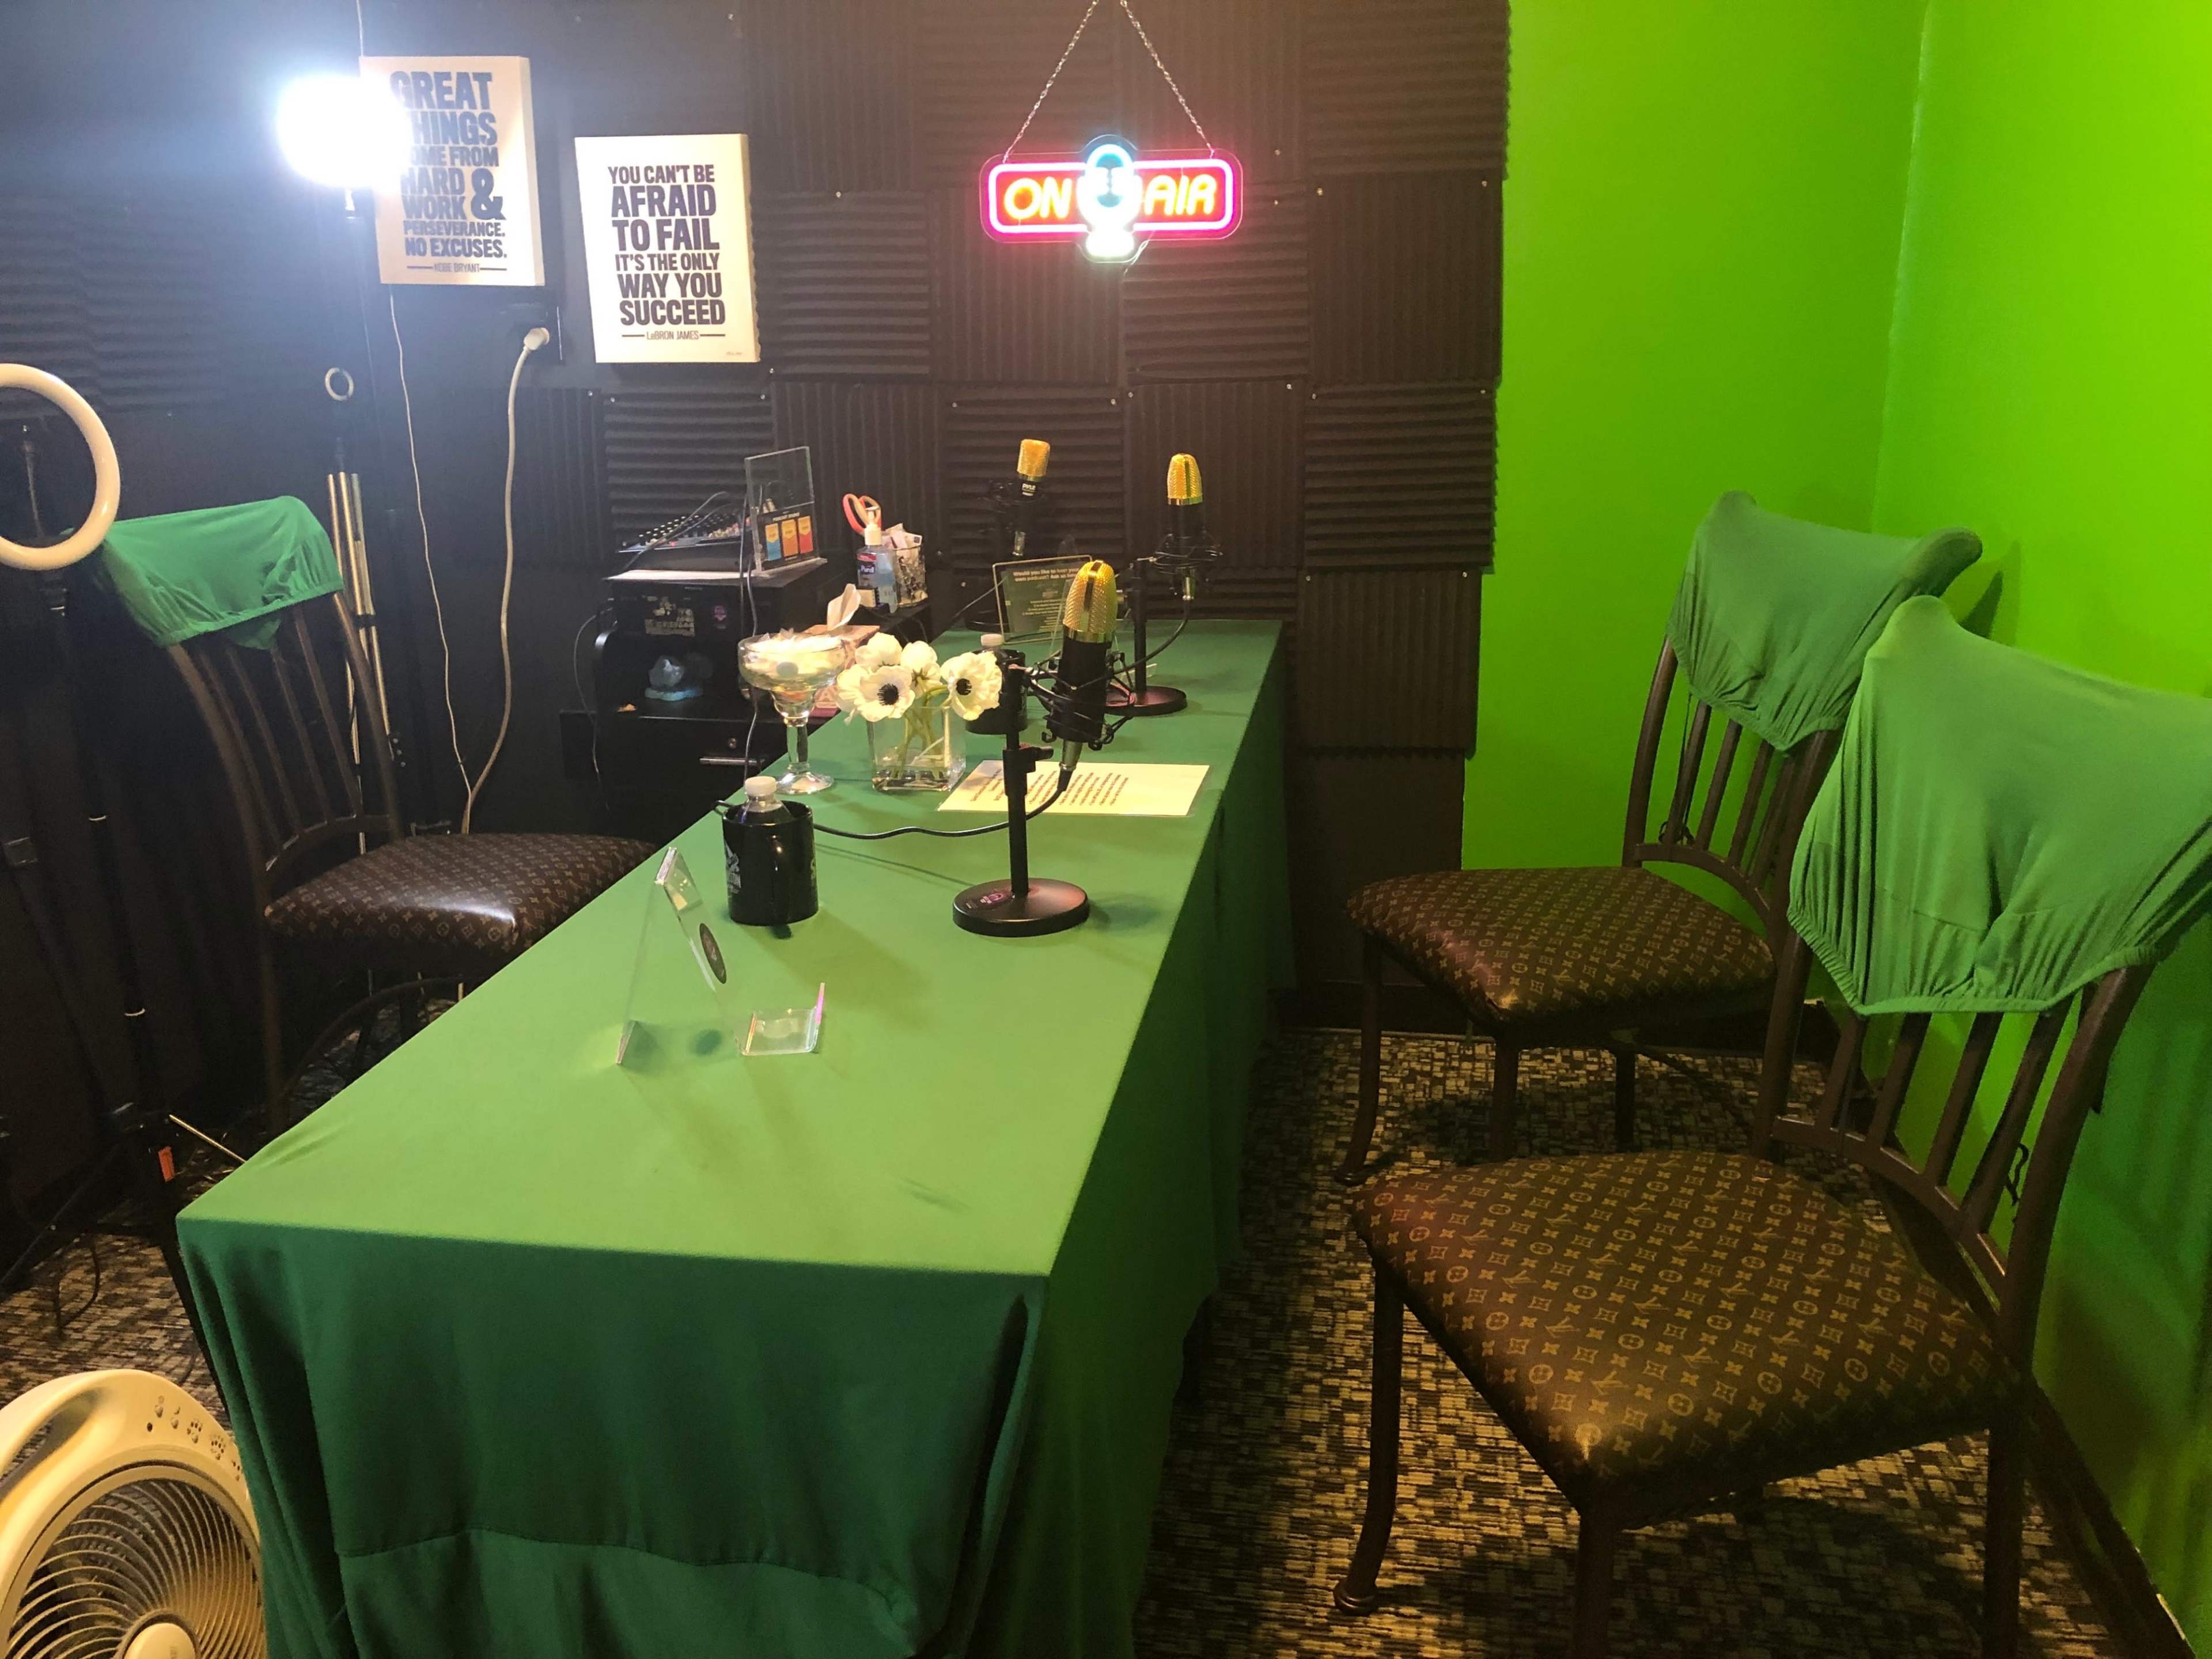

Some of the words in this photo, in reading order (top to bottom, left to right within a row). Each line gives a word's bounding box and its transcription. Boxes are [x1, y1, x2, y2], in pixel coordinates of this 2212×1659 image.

[390, 71, 493, 110] GREAT
[408, 111, 498, 146] HINGS
[449, 147, 499, 166] FROM
[401, 167, 465, 195] HARD
[608, 165, 641, 184] YOU
[644, 165, 690, 184] CAN'T
[693, 164, 715, 183] BE
[402, 196, 467, 219] WORK
[471, 168, 506, 220] &
[611, 184, 717, 217] AFRAID
[1003, 176, 1073, 220] ON
[1143, 173, 1218, 216] AIR
[403, 220, 505, 237] PERSEVERANCE.
[611, 219, 650, 251] TO
[656, 218, 720, 251] FAIL
[404, 237, 427, 256] NO
[430, 238, 507, 258] EXCUSES.
[453, 263, 480, 272] BRYANT
[615, 253, 645, 271] IT'S
[647, 253, 677, 271] THE
[680, 252, 719, 270] ONLY
[617, 272, 669, 298] WAY
[675, 272, 722, 298] YOU
[619, 299, 726, 325] SUCCEED
[676, 331, 699, 340] JAMES
